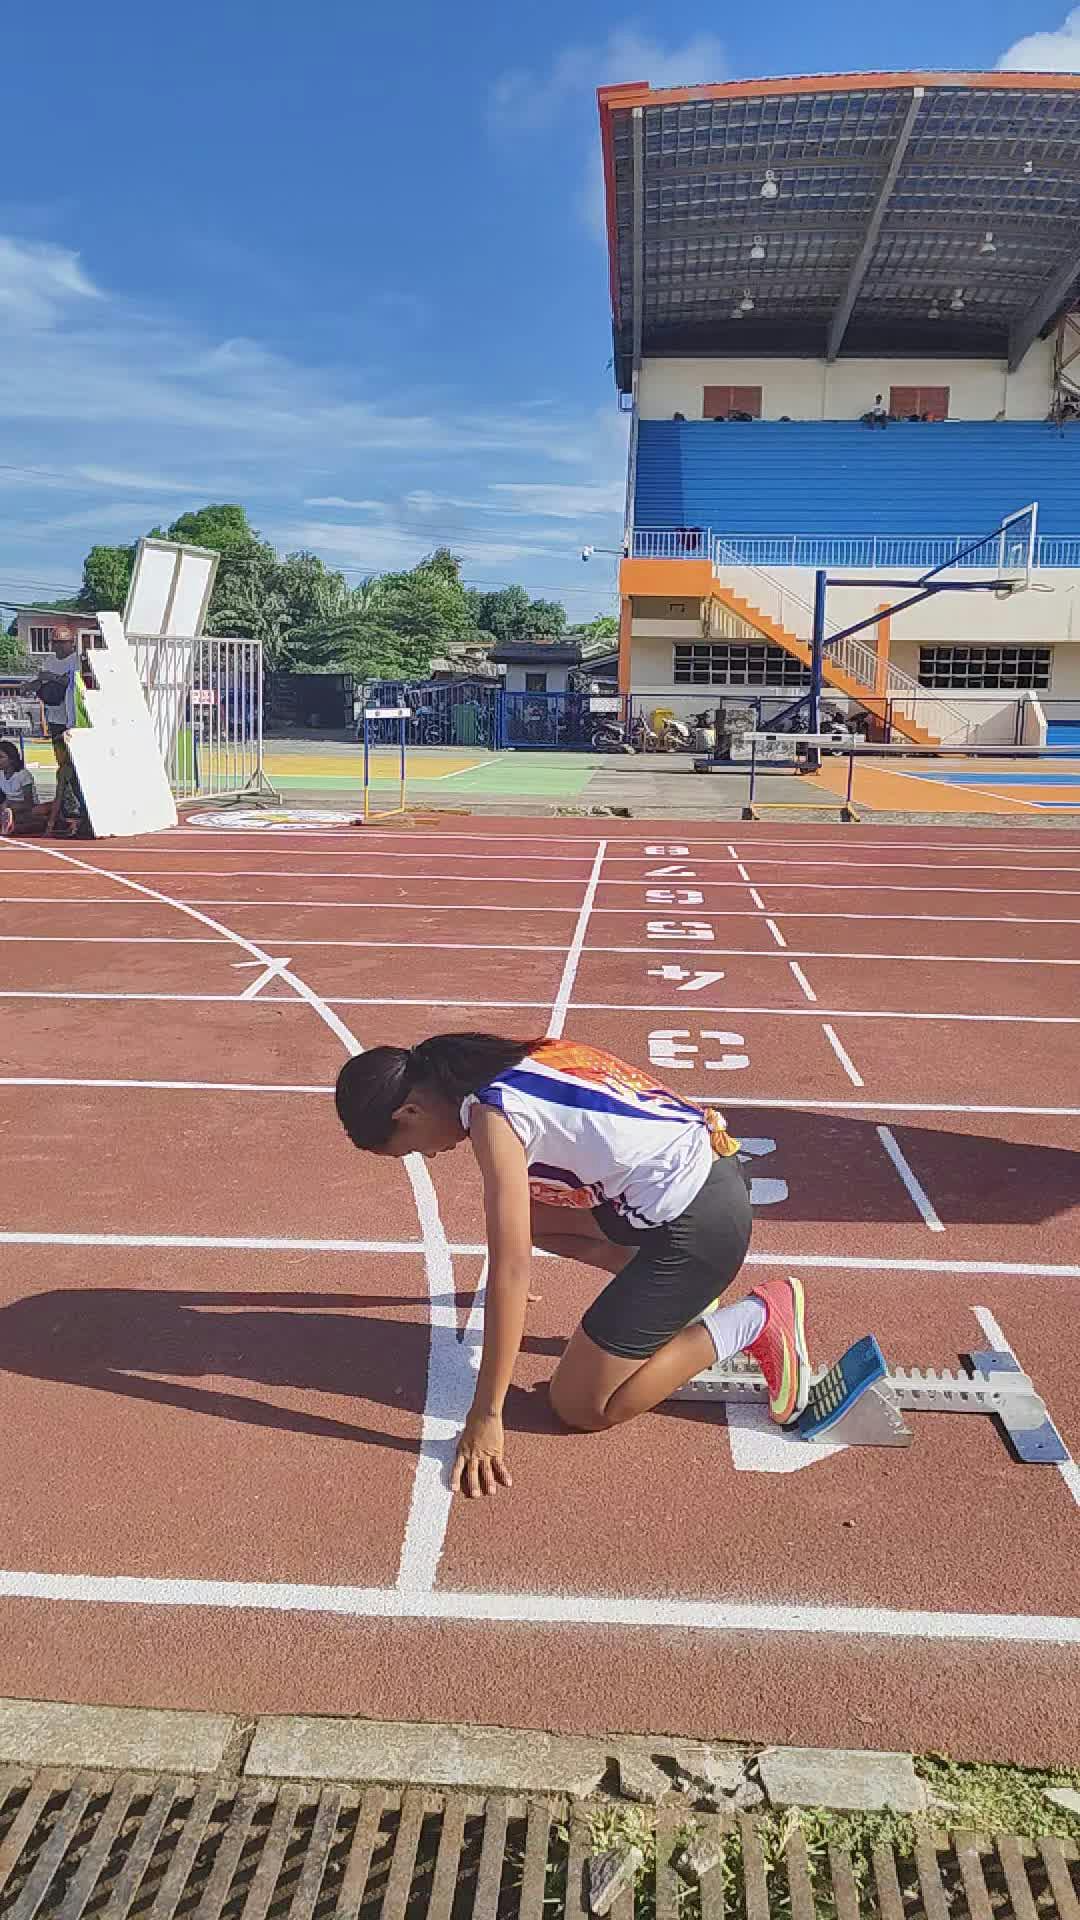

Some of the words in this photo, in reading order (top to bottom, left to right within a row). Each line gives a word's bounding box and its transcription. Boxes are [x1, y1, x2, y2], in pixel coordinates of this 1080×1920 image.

[644, 865, 697, 877] 7
[646, 921, 714, 940] 5
[647, 965, 725, 991] 4
[648, 1029, 751, 1071] 3
